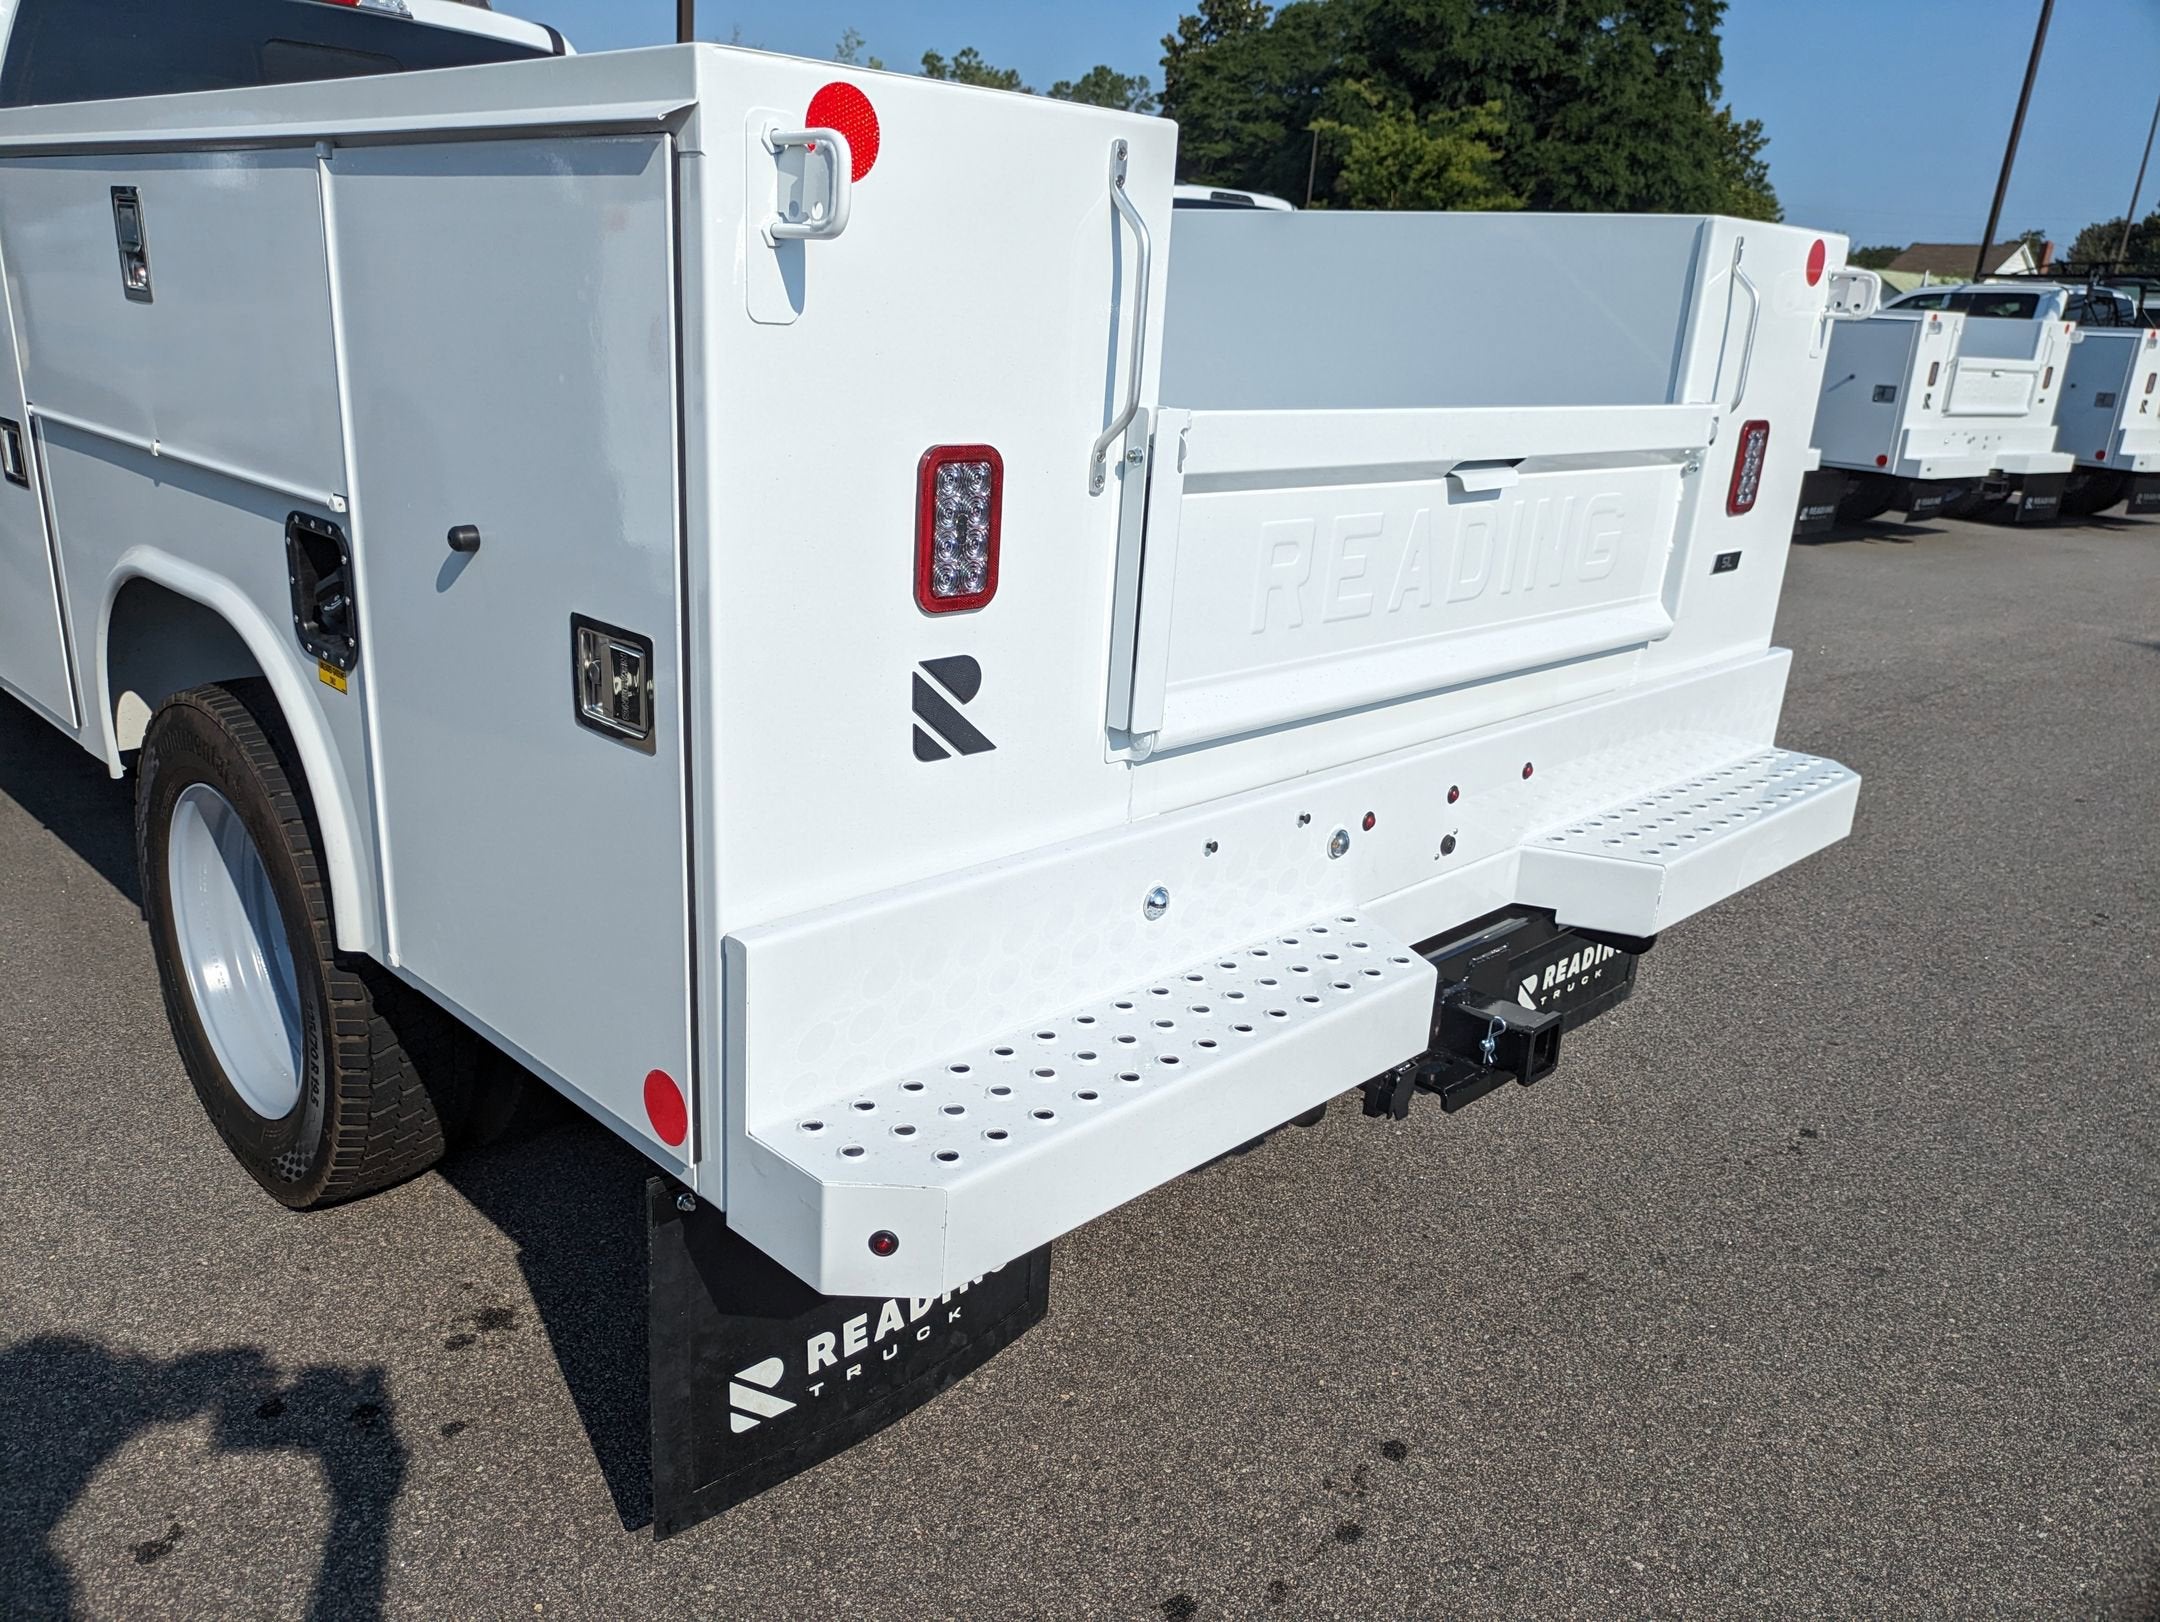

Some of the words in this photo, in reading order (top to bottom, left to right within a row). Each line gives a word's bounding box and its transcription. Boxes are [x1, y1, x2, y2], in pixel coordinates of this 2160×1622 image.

[1251, 493, 1625, 635] READING
[1540, 969, 1603, 1006] TRUCK
[1542, 943, 1622, 990] READIN
[807, 1263, 1007, 1375] READ
[808, 1307, 962, 1397] TRUCK
